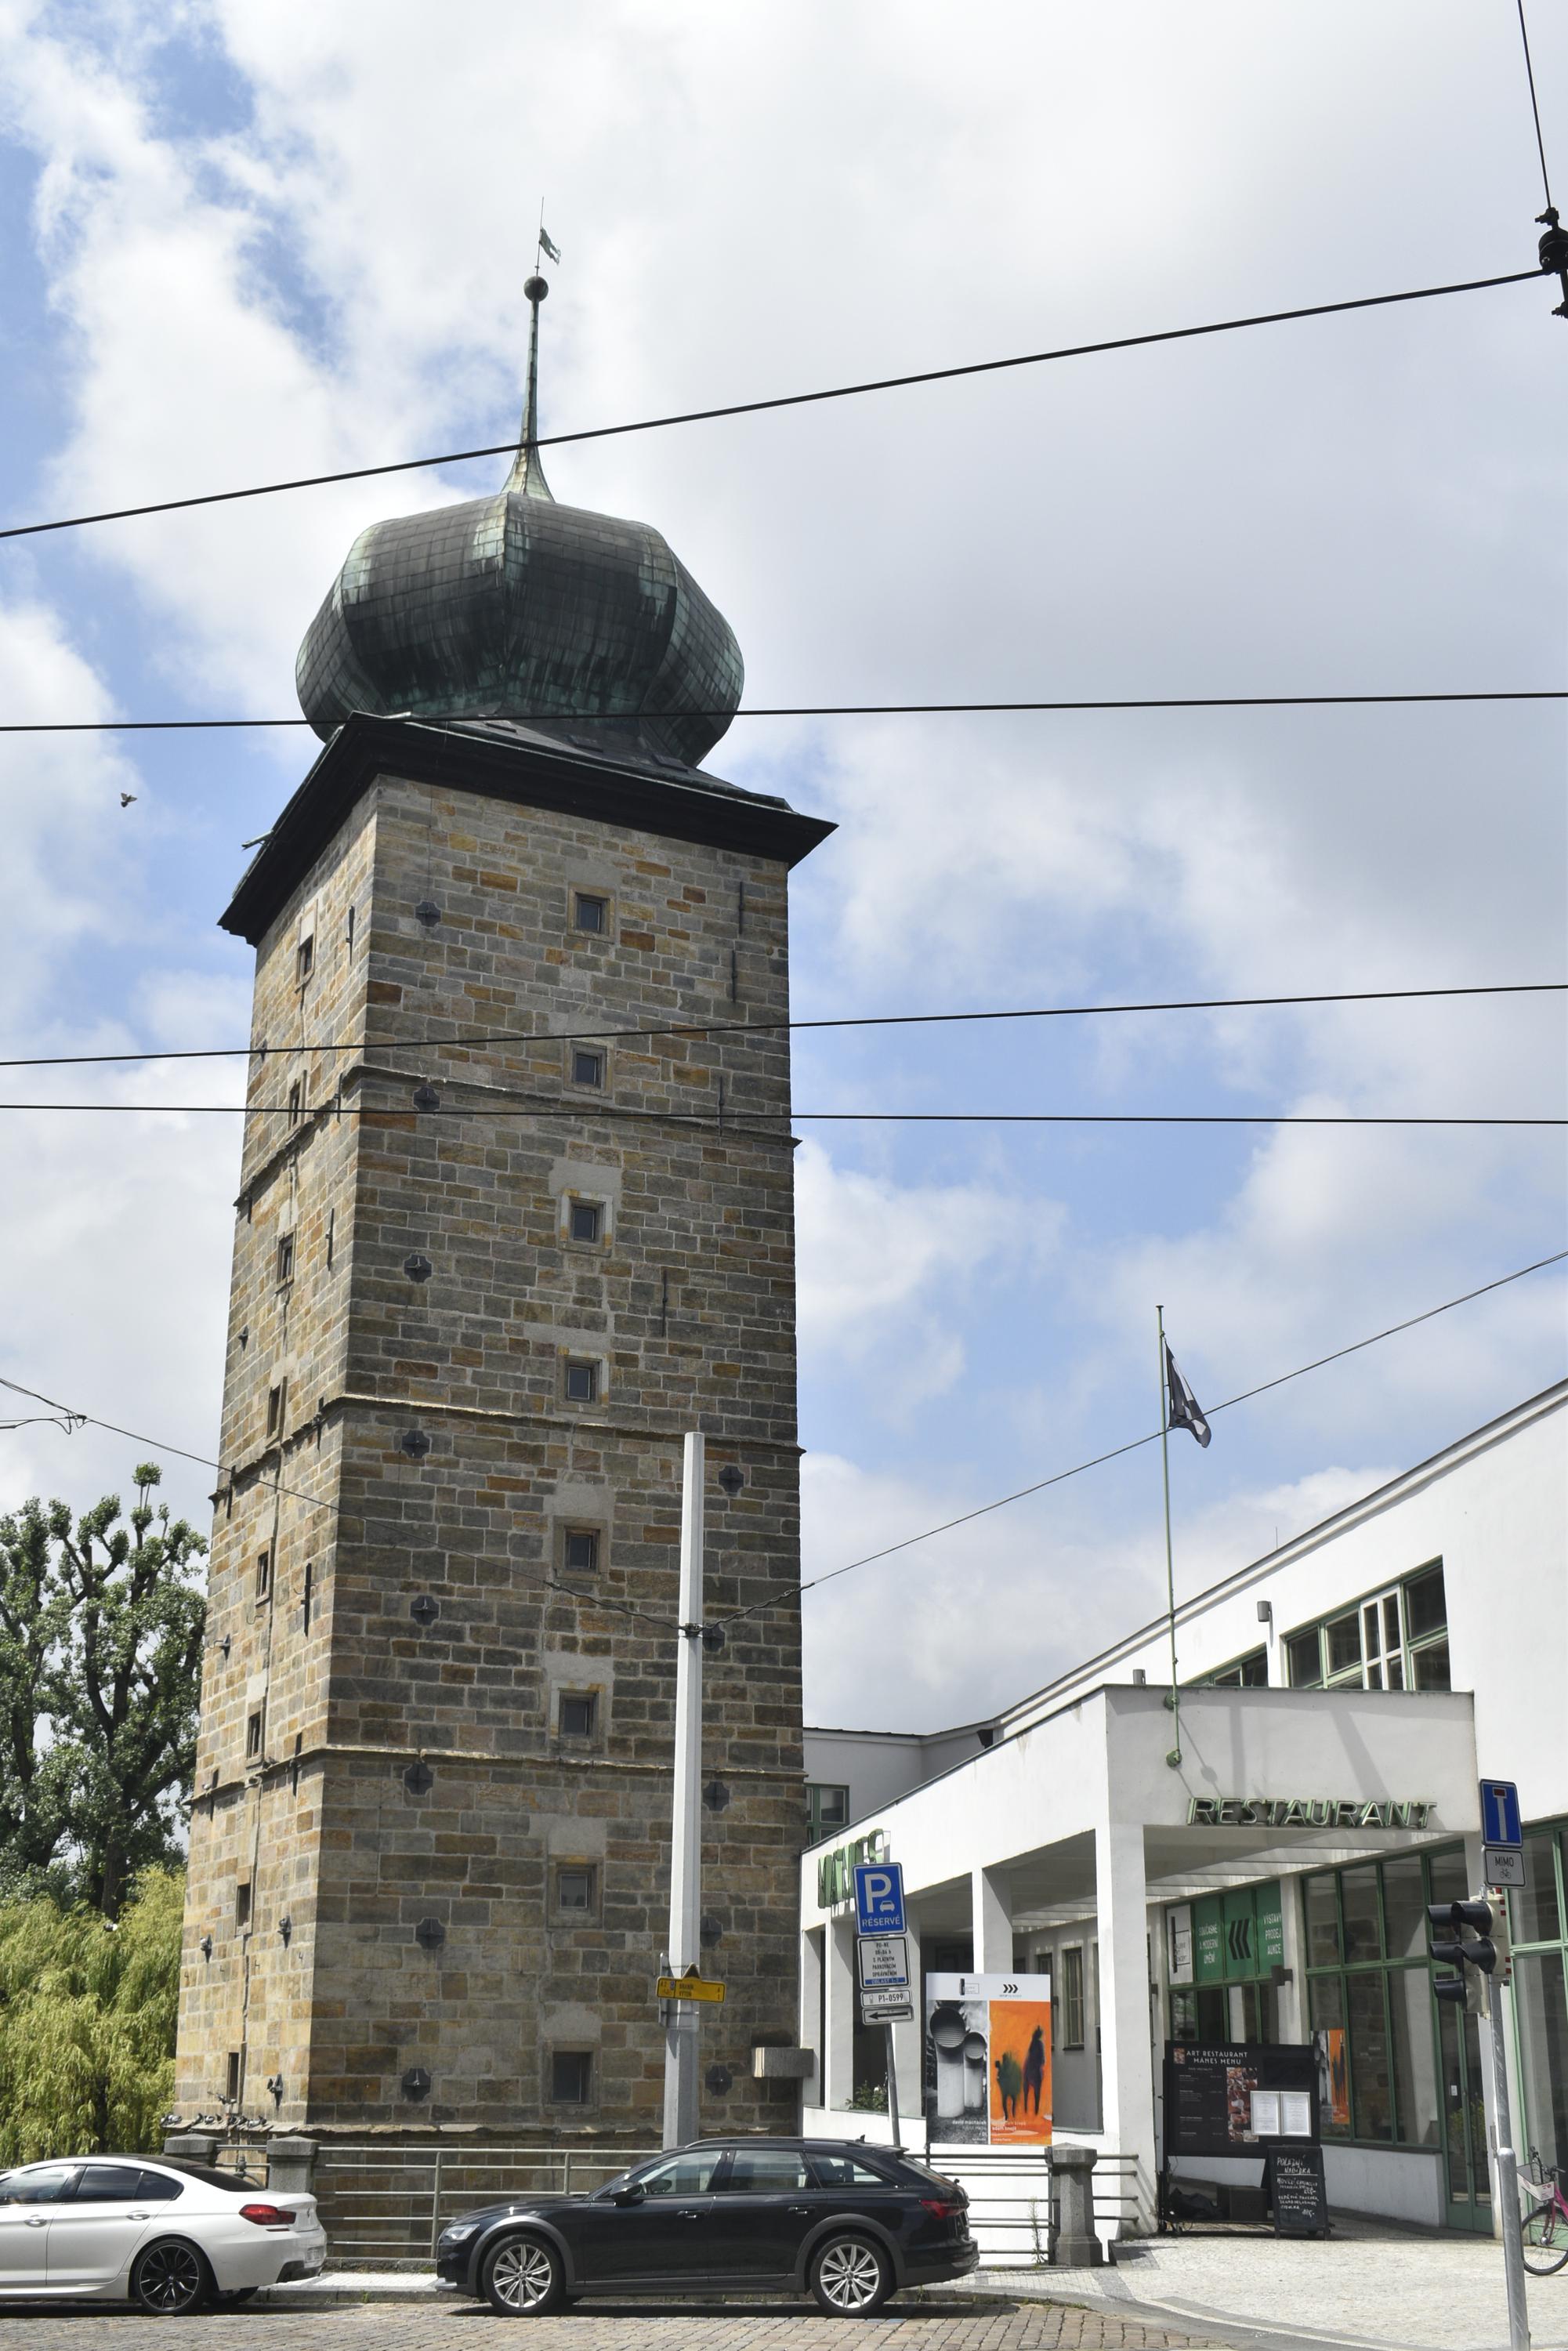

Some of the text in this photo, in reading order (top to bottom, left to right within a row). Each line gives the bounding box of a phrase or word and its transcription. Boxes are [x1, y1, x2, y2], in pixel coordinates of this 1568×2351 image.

[1187, 1797, 1437, 1829] RESTAURANT
[1494, 1856, 1515, 1867] MIMO
[864, 1873, 892, 1913] P
[862, 1914, 900, 1927] RÉSERVÉ
[1266, 1928, 1281, 1940] PRODEJ
[1268, 1943, 1281, 1954] AUKCE
[878, 1993, 904, 2003] P1-0599
